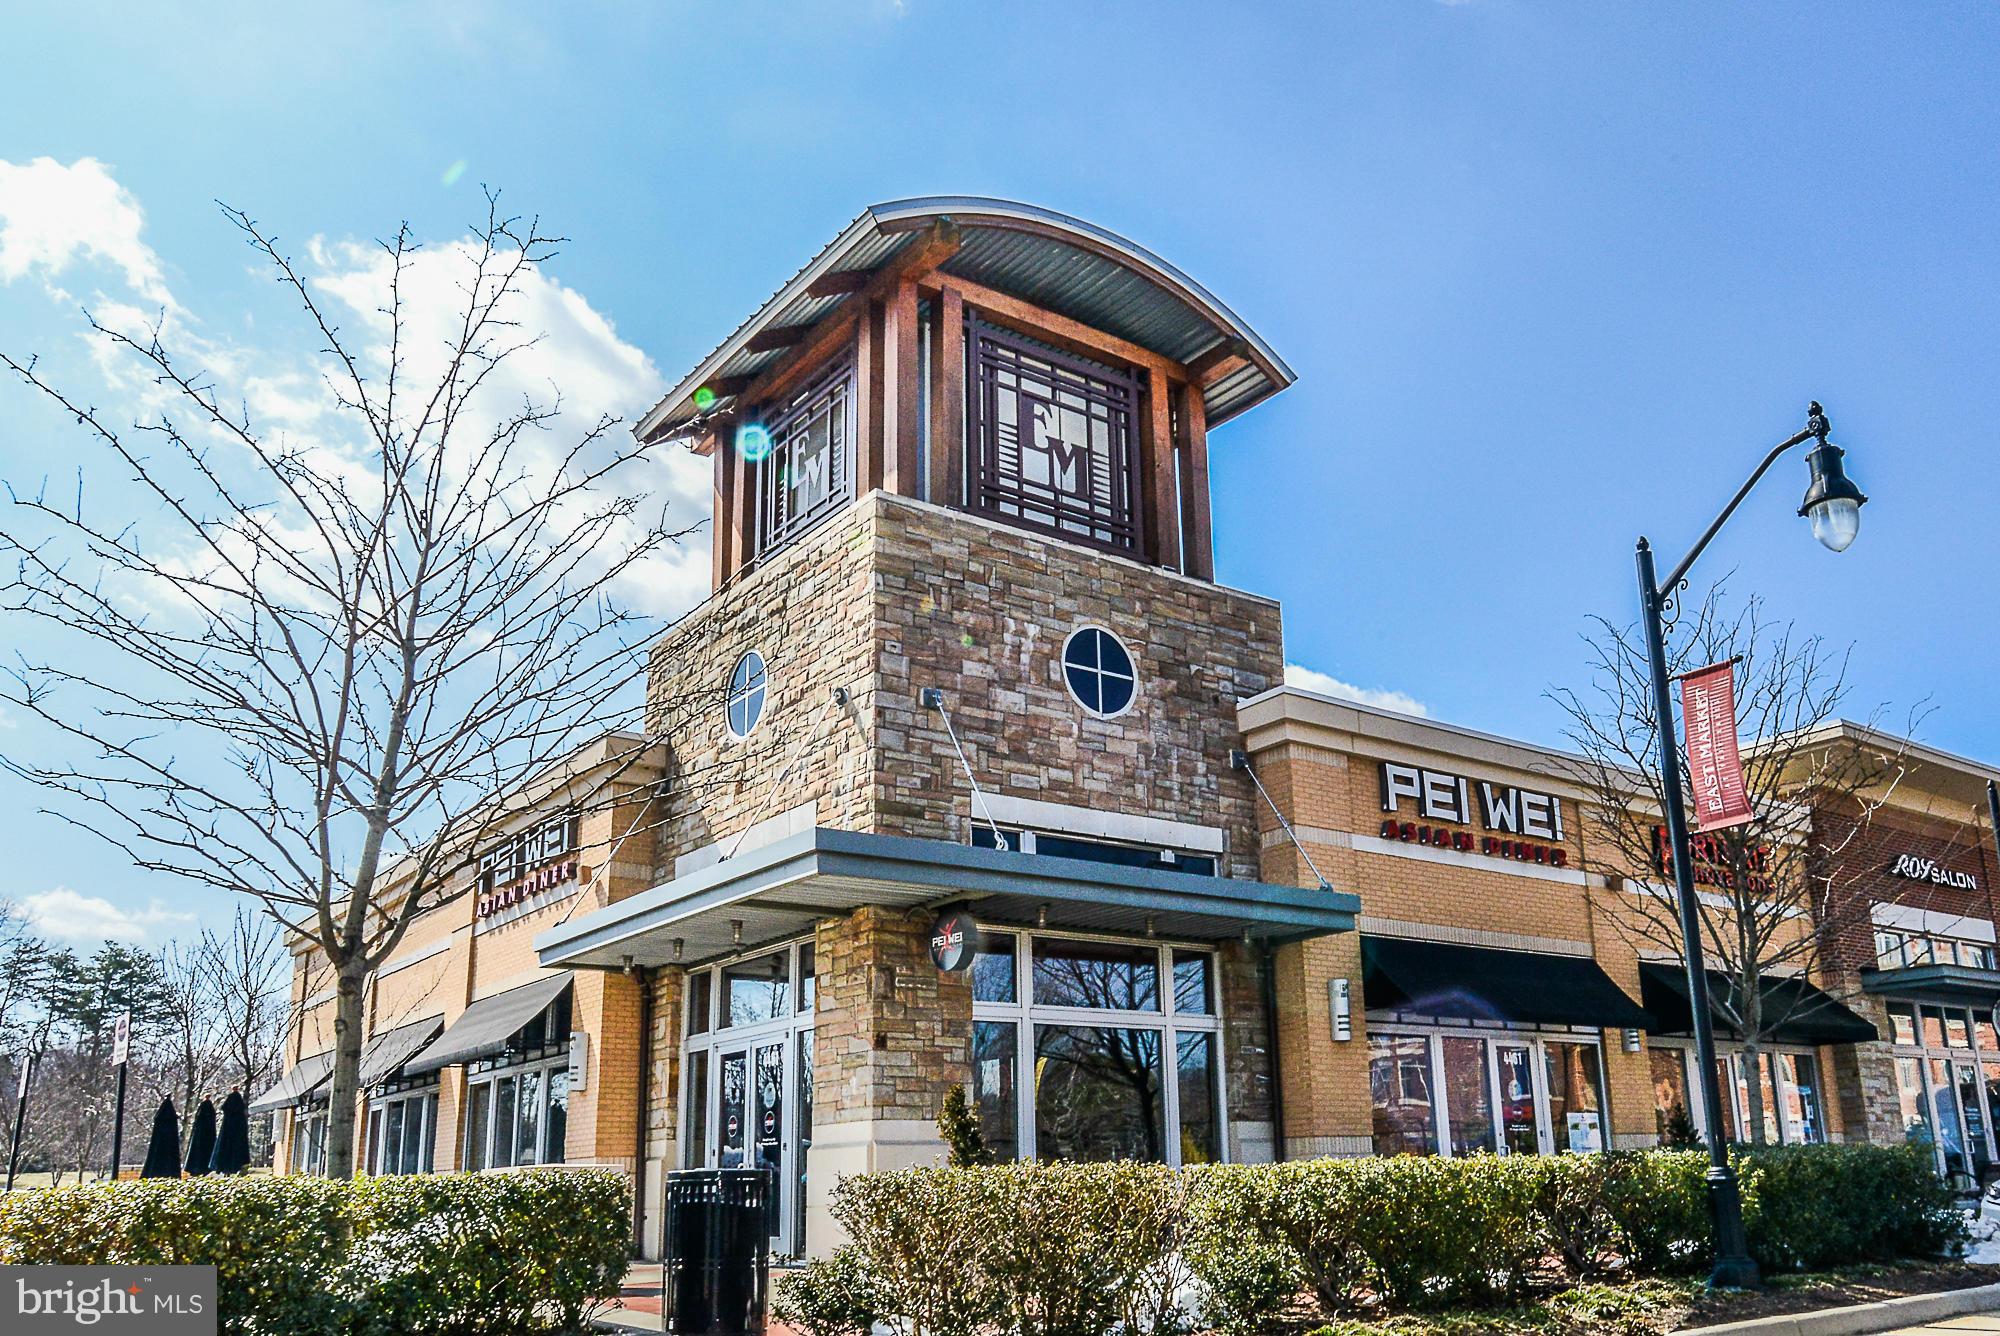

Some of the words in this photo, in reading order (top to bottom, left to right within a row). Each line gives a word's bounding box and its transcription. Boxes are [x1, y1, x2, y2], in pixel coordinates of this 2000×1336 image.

[1695, 687, 1713, 760] MARKET
[1383, 763, 1470, 824] PEI
[1480, 782, 1564, 841] WEI
[1702, 766, 1724, 813] EAST
[477, 837, 518, 896] PEI
[524, 821, 570, 874] WEI
[1381, 819, 1475, 850] ASIAN
[1482, 836, 1567, 867] DINER
[475, 885, 517, 918] ASIAN
[522, 860, 569, 897] DINER
[1892, 853, 1935, 879] ROY
[1931, 867, 1977, 890] SALON
[932, 935, 946, 948] PEI
